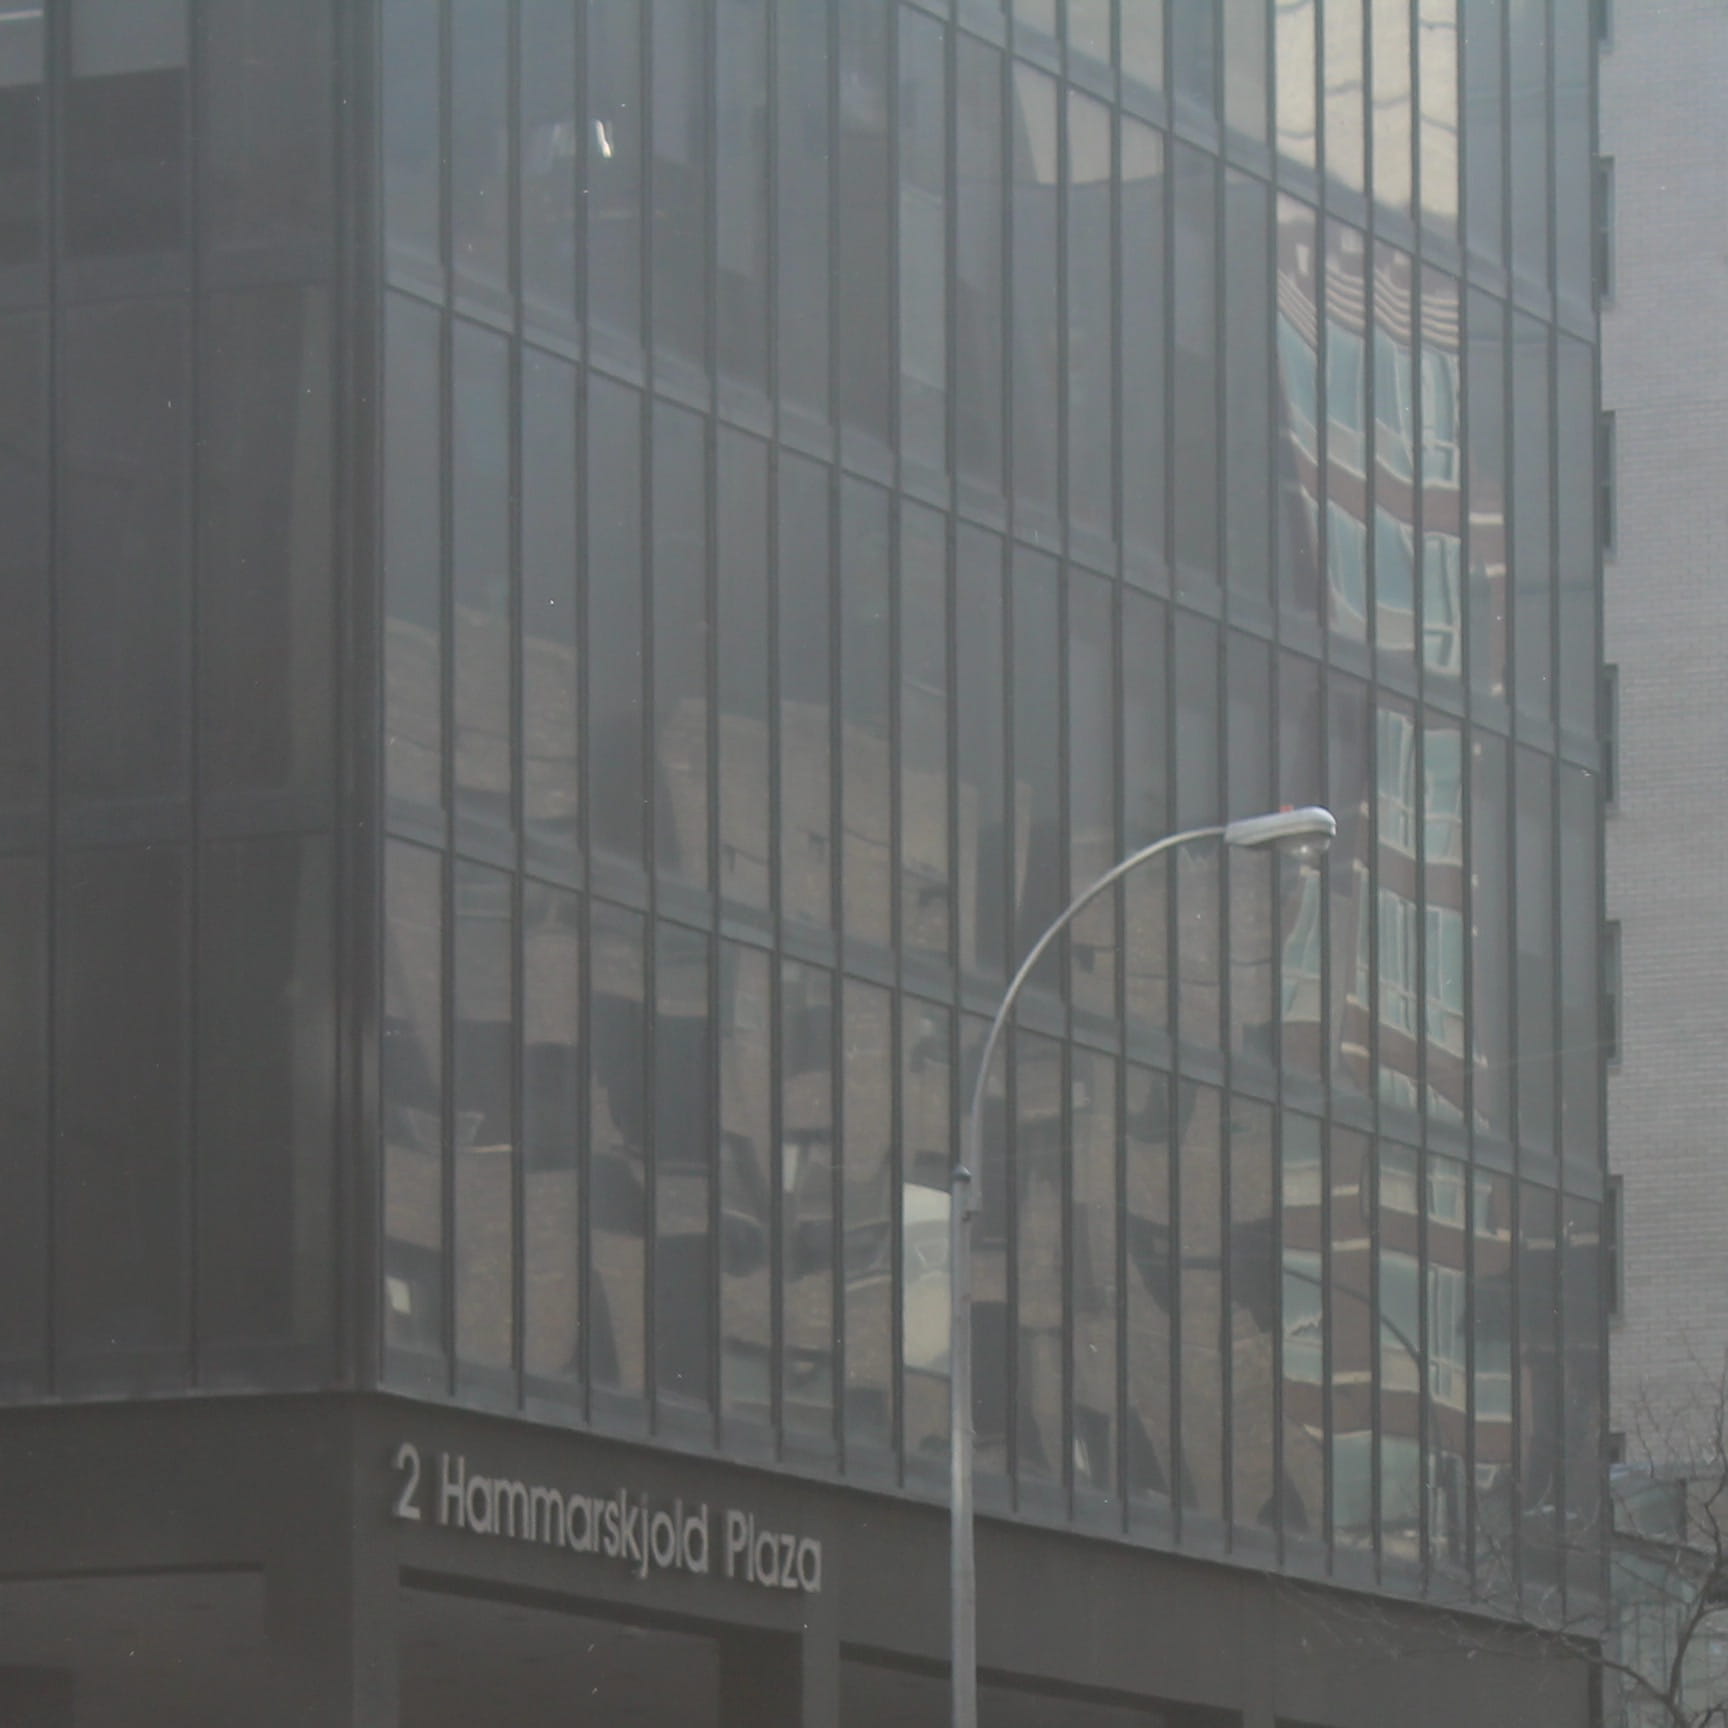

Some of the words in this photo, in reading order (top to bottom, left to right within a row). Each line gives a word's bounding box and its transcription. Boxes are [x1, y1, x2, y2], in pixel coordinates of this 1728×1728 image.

[394, 1442, 422, 1520] 2
[439, 1452, 710, 1580] Hammarskjold
[725, 1509, 822, 1592] Plaza
